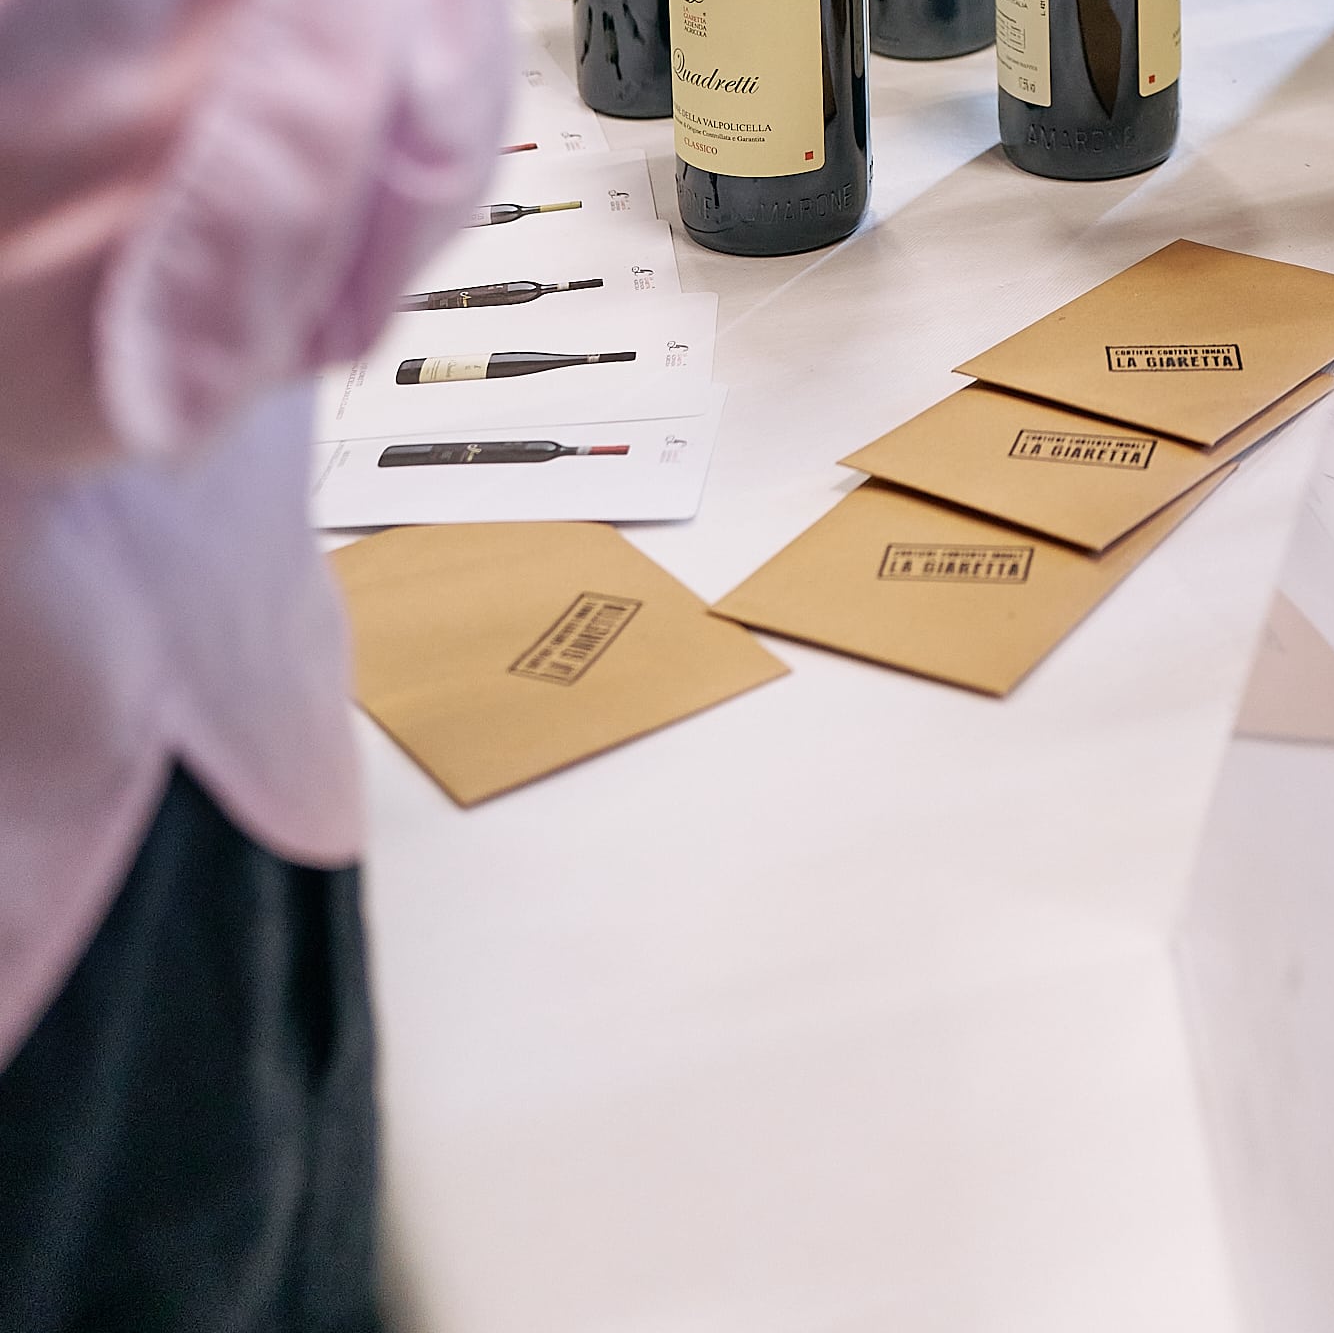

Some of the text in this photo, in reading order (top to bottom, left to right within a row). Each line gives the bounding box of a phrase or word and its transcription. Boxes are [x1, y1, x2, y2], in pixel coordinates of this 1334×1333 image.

[673, 47, 760, 95] Quadretti
[703, 117, 773, 133] VALPOLICELLA
[684, 137, 718, 156] CLASSICO
[737, 135, 766, 143] Garantita
[1116, 355, 1234, 368] LA GIARETTA
[1020, 443, 1142, 464] LA GIARETTA
